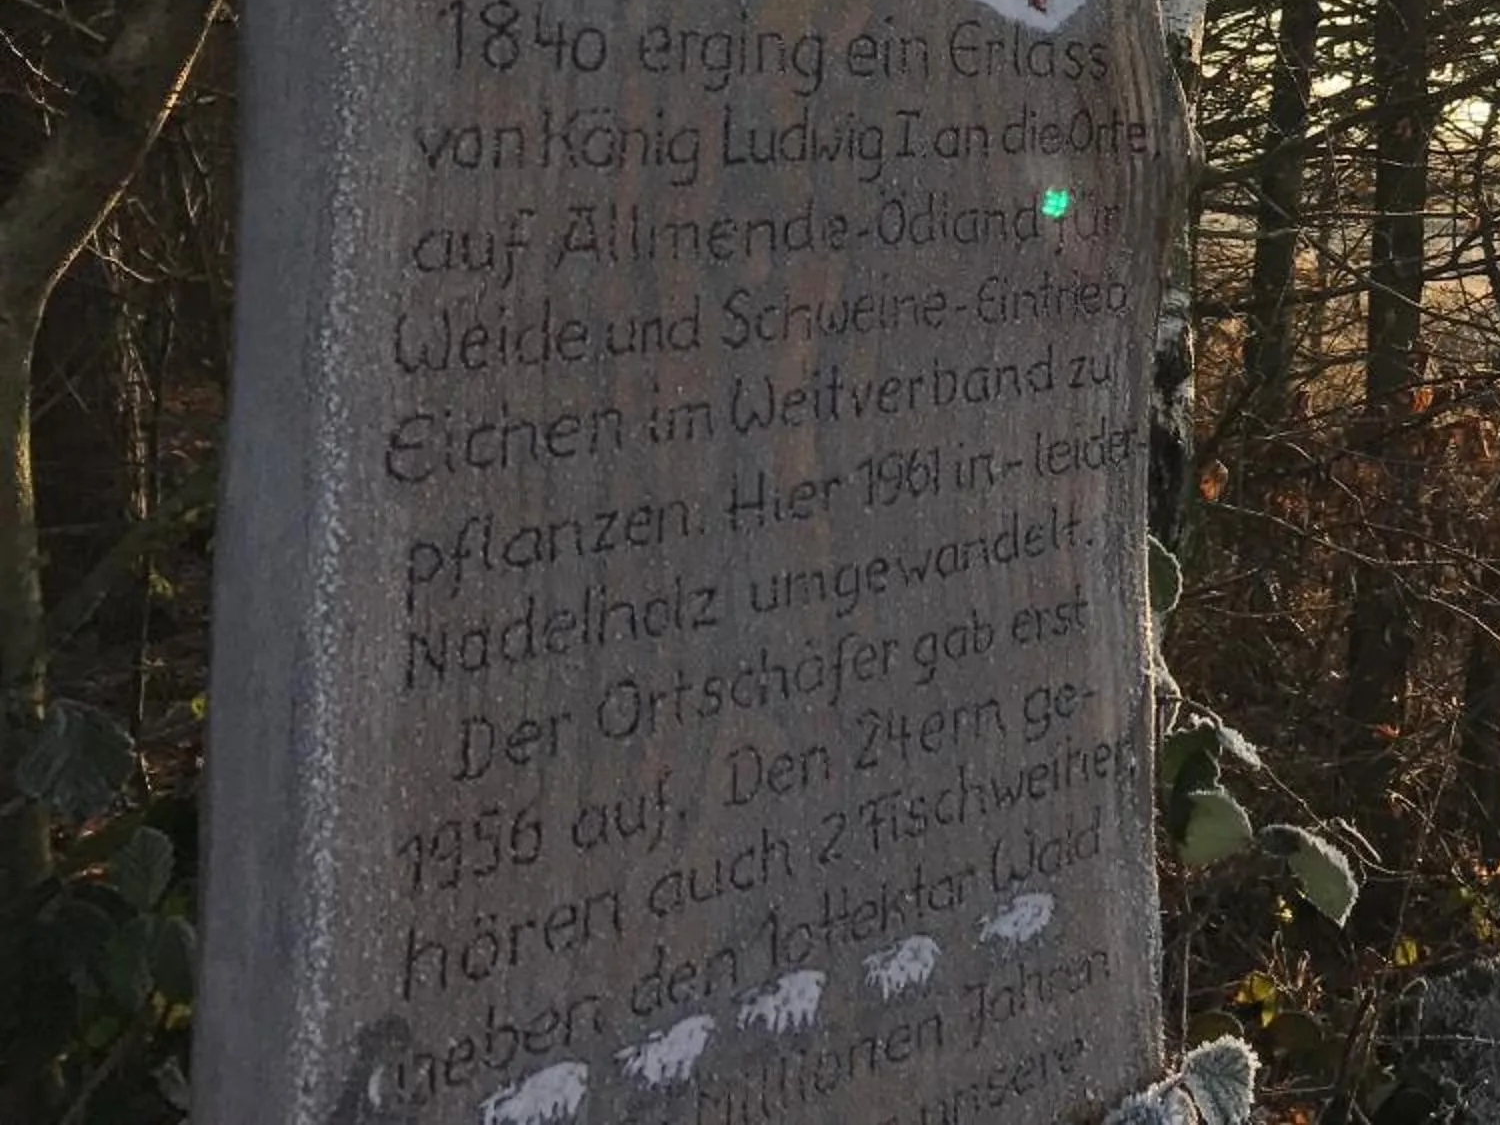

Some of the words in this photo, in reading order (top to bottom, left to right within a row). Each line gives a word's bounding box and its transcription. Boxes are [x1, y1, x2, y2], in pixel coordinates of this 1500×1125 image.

[638, 12, 824, 98] erging
[847, 13, 929, 77] ein
[948, 17, 1109, 79] Erlass
[541, 105, 700, 187] König
[722, 103, 884, 184] Ludwig
[934, 121, 989, 159] an
[1002, 101, 1063, 156] die
[412, 206, 537, 290] auf
[394, 297, 589, 373] Weide
[606, 294, 700, 357] und
[385, 398, 624, 483] Eichen
[649, 379, 714, 444] im
[727, 470, 842, 533] Hier
[404, 575, 718, 693] Nadelholz
[451, 710, 572, 783] Der
[913, 608, 995, 684] gab
[1011, 584, 1088, 645] erst
[724, 742, 831, 807] Den
[402, 887, 622, 1002] hören
[648, 826, 792, 918] auch
[816, 811, 847, 865] 2
[632, 944, 738, 1017] den
[990, 804, 1102, 892] Wald
